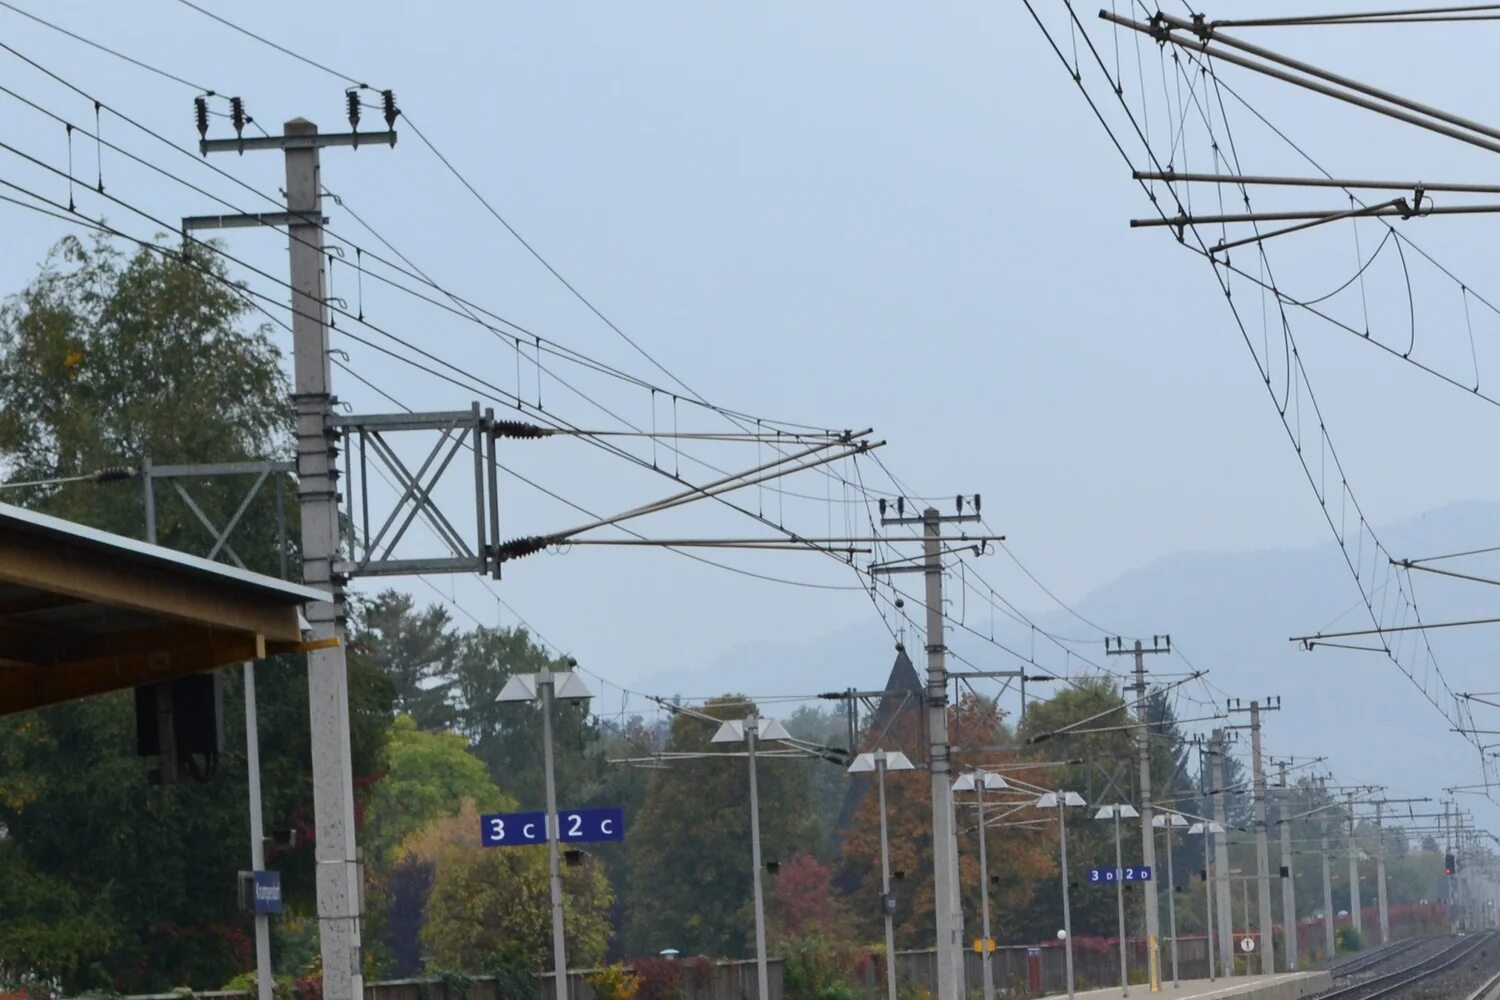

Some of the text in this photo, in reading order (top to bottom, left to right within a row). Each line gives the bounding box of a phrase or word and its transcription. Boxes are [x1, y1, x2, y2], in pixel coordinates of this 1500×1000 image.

[490, 818, 505, 840] 3
[567, 814, 583, 837] 2
[1091, 870, 1113, 881] 3 D
[1126, 868, 1148, 880] 2 D
